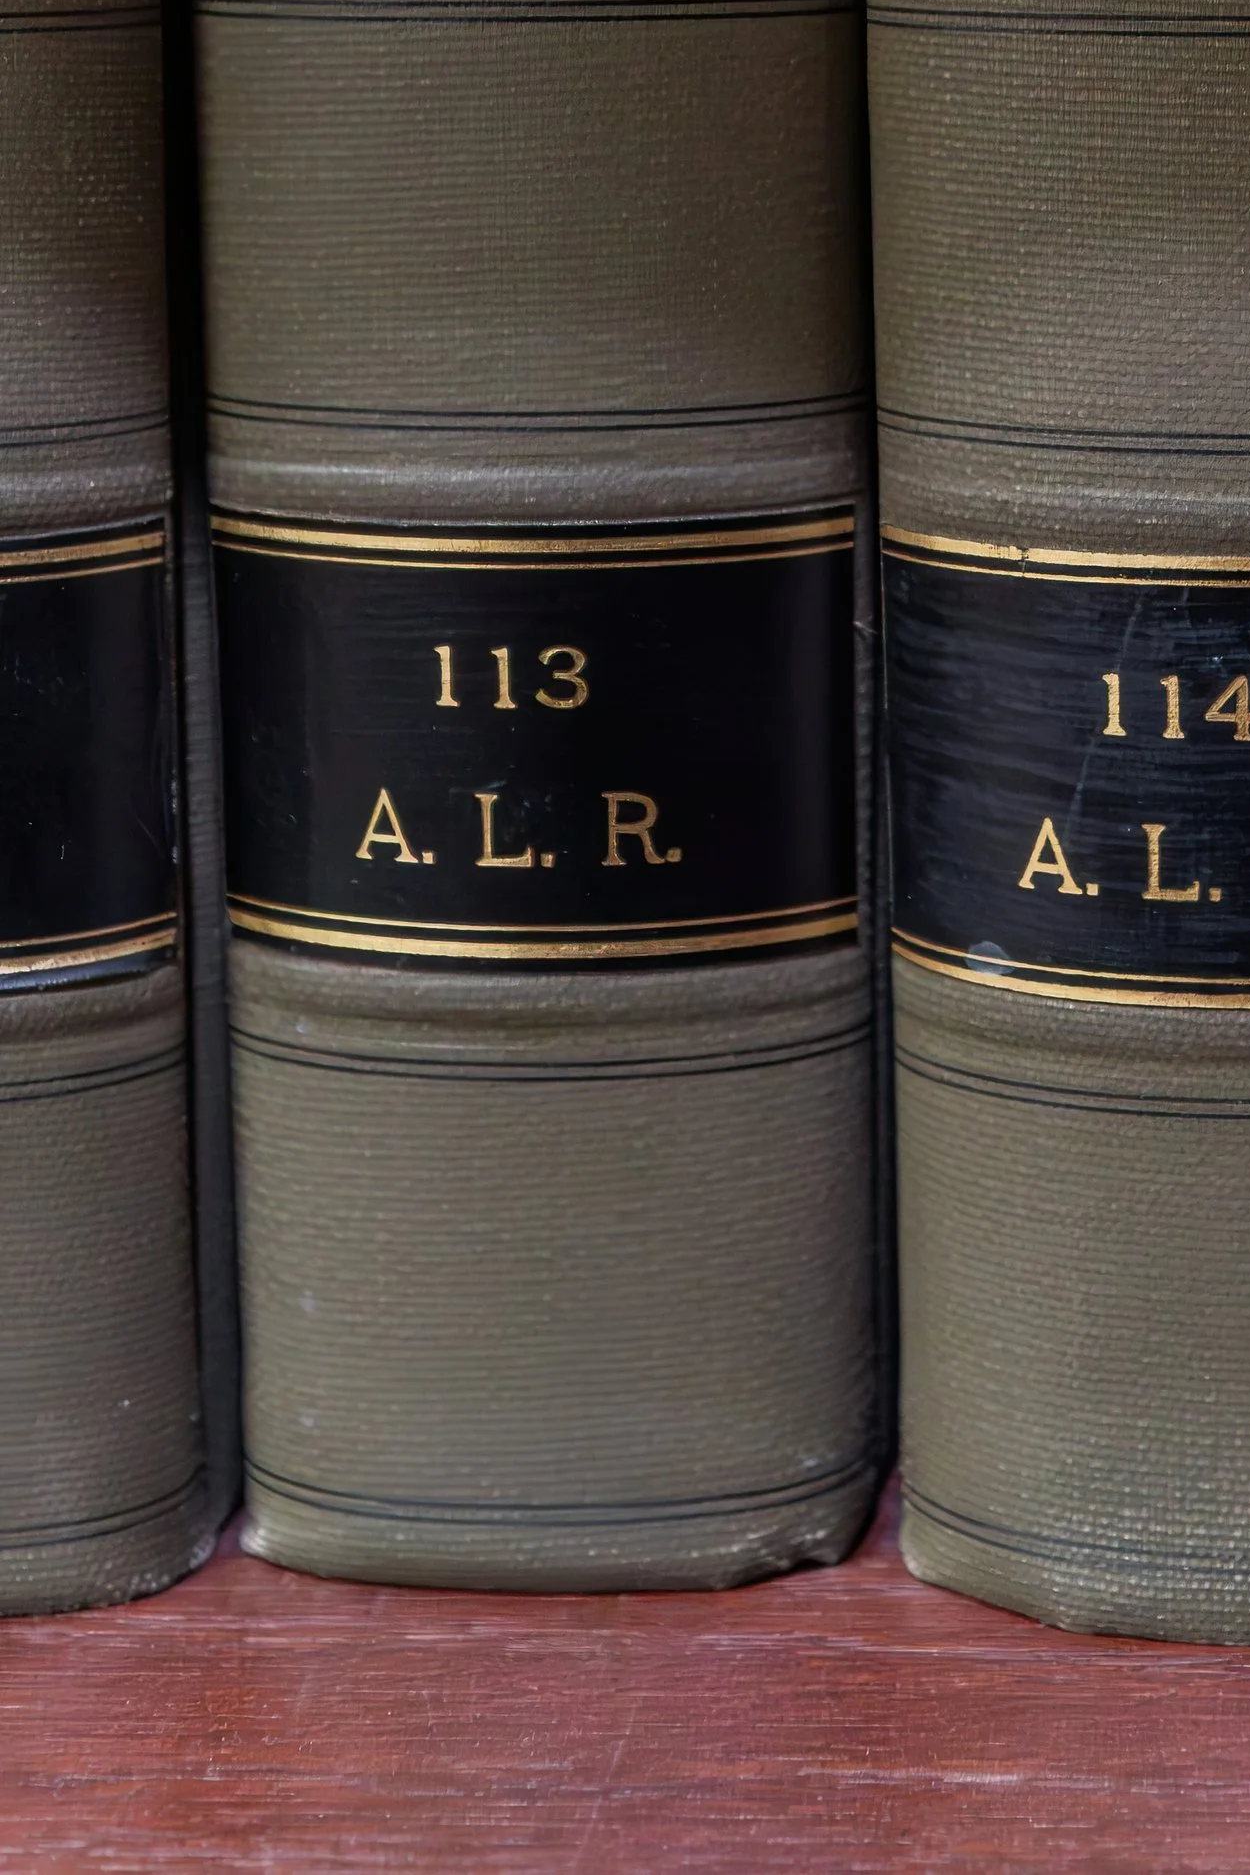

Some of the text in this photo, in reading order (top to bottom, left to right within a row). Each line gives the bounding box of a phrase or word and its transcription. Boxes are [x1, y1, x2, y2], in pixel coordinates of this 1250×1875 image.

[434, 644, 588, 709] 113
[356, 788, 682, 869] A. L. R.
[1018, 817, 1100, 897] A.
[1142, 824, 1223, 903] L.
